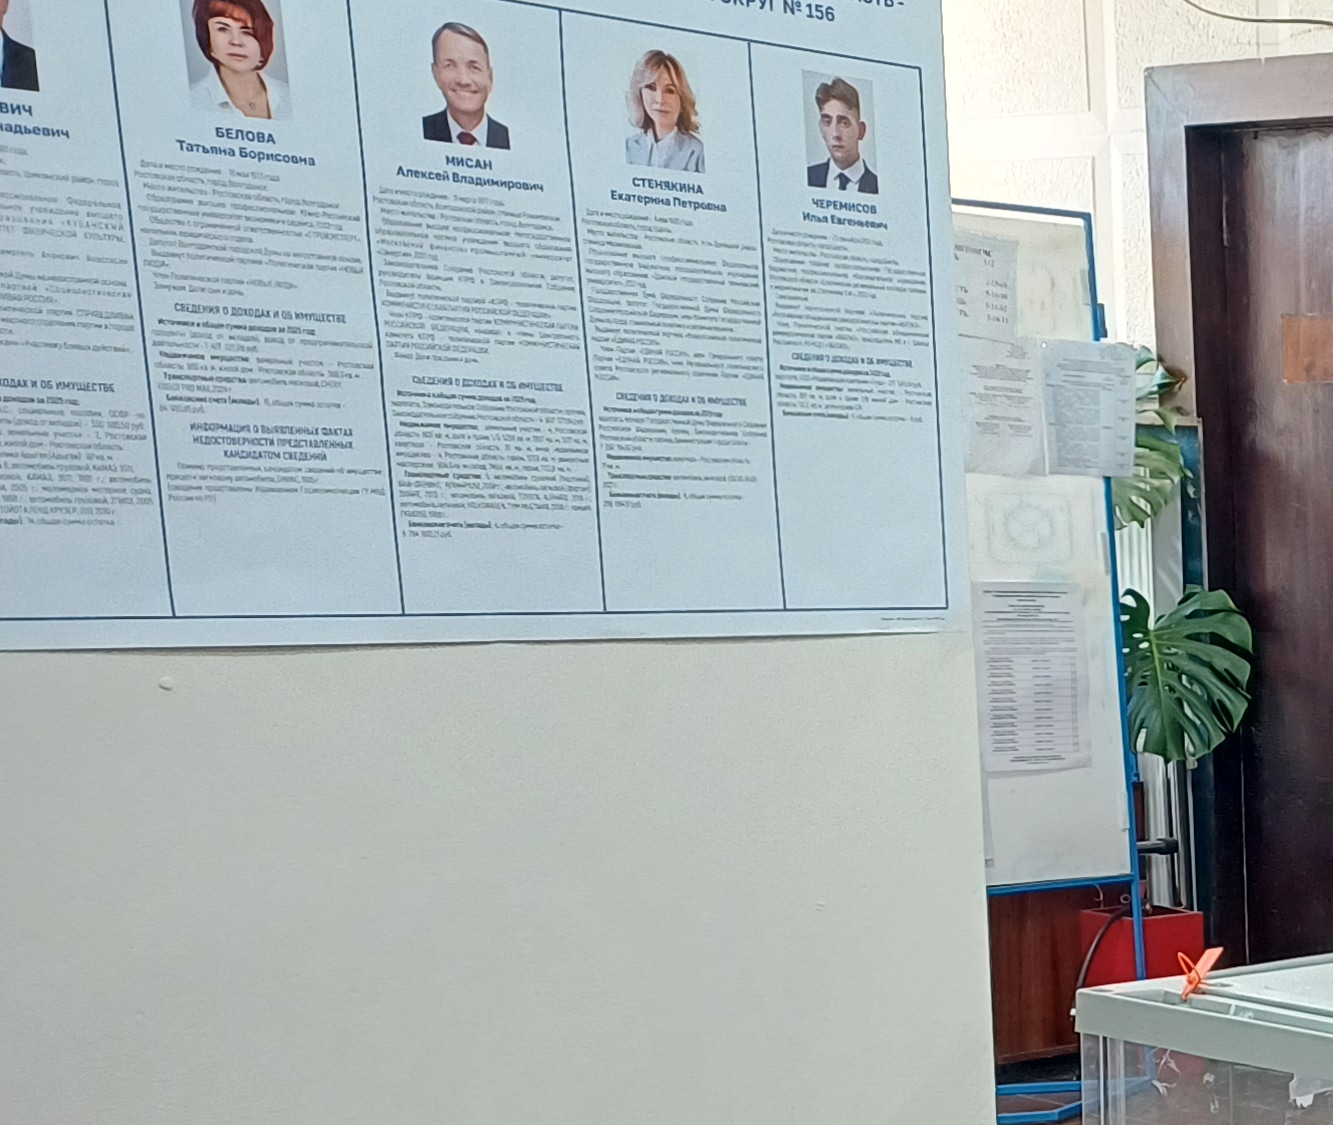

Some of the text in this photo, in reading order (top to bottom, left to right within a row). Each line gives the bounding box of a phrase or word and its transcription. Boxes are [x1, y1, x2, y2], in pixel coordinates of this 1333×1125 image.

[215, 127, 276, 144] БЕЛОВА
[176, 139, 316, 166] Татьяна Борисовна
[445, 155, 492, 170] МИСАН
[396, 166, 544, 192] Алексей Владимирович
[632, 177, 704, 195] СТЕНЯКИНА
[610, 190, 727, 212] Екатерина Петровна
[812, 198, 877, 214] ЧЕРЕМИСОВ
[802, 212, 888, 230] Илья Евгеньевич
[174, 302, 221, 315] СВЕДЕНИЯ
[230, 307, 271, 318] ДОХОДАХ
[281, 311, 293, 320] ОБ
[294, 312, 347, 324] ИМУЩЕСТВЕ
[55, 381, 115, 393] ИМУЩЕСТВЕ
[189, 423, 251, 434] ИНФОРМАЦИЯ
[260, 425, 319, 437] ВЫЯВЛЕННЫХ
[321, 427, 353, 437] ФАКТАХ
[193, 436, 353, 449] НЕДОСТОВЕРНОСТИ ПРЕДСТАВЛЕННЫХ
[223, 449, 327, 462] КАНДИДАТОМ СВЕДЕНИЙ
